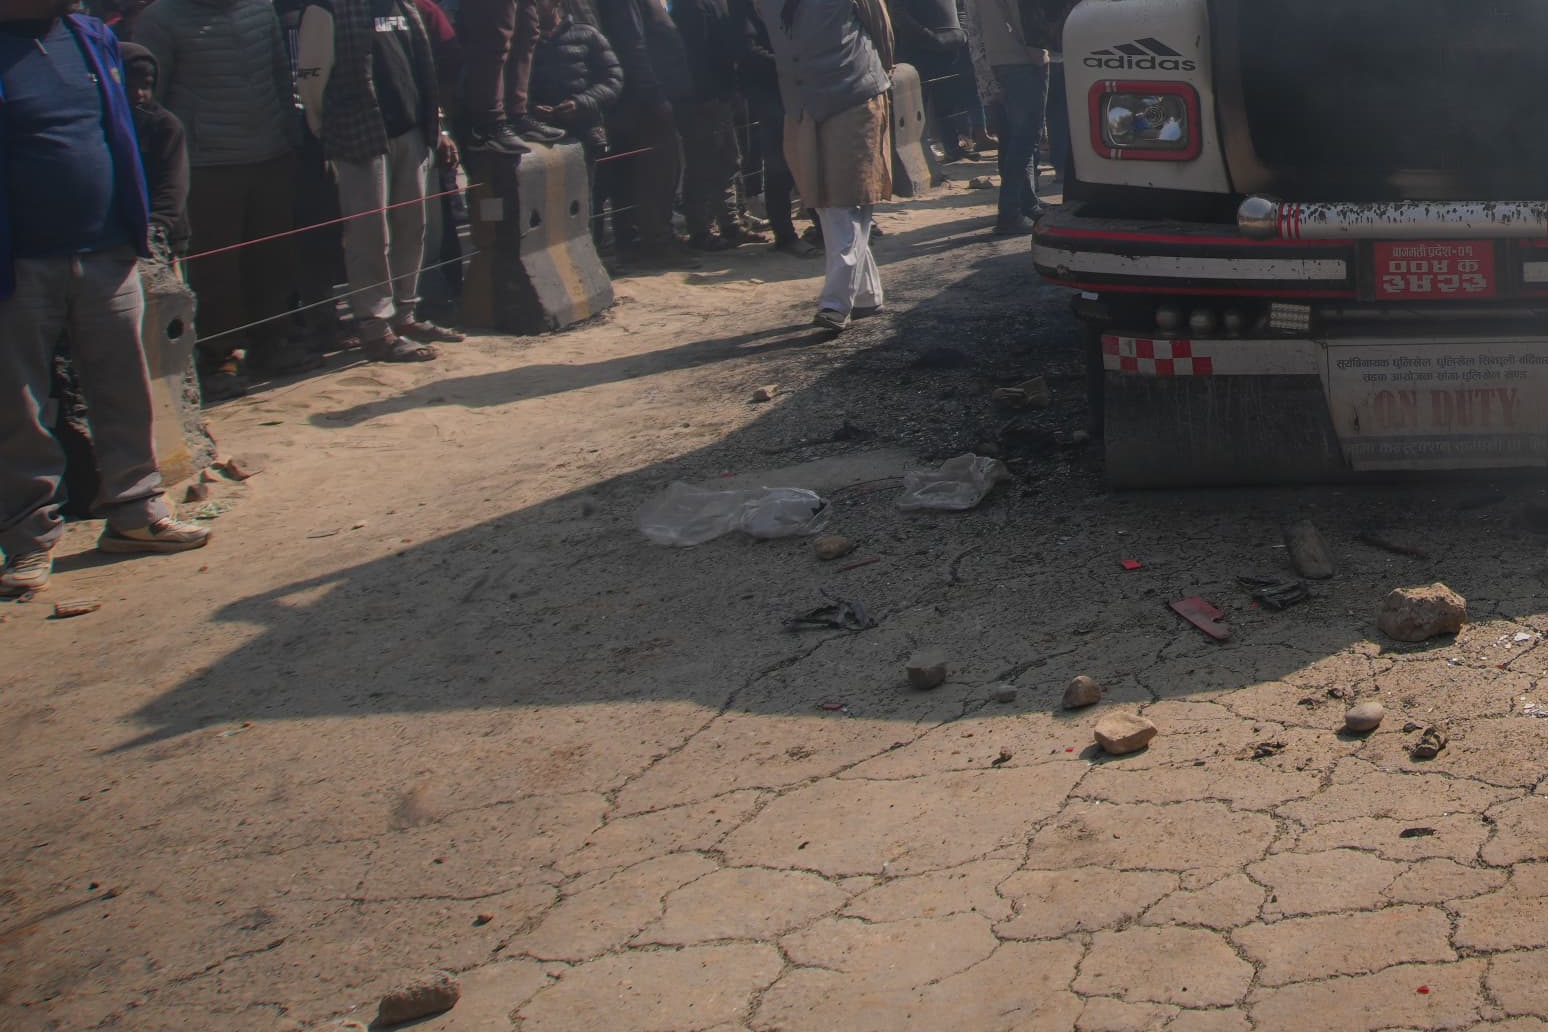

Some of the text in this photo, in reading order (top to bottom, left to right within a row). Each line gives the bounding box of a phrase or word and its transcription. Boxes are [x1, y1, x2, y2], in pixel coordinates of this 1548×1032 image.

[374, 15, 409, 32] UFC
[1083, 55, 1196, 71] adidas
[1374, 387, 1520, 426] ON DUTY
